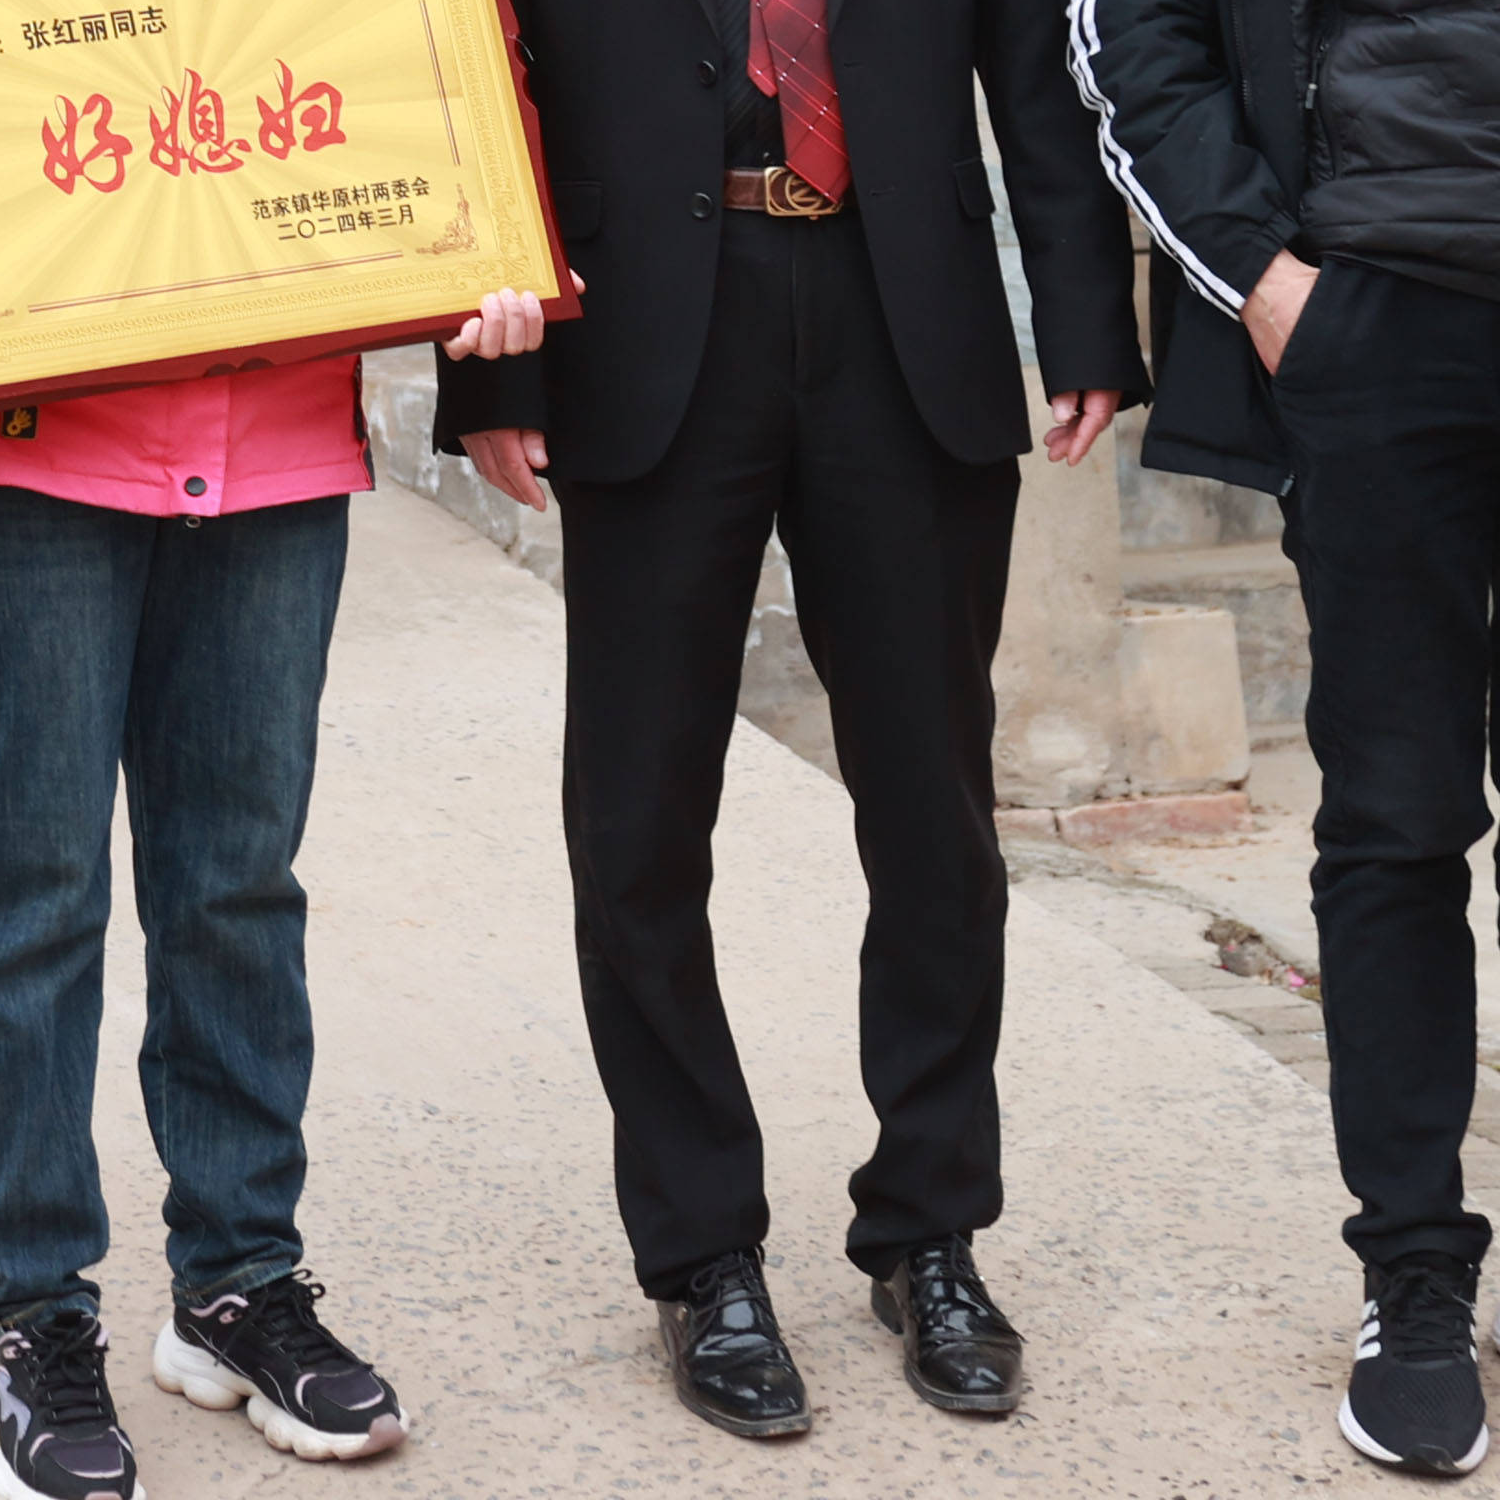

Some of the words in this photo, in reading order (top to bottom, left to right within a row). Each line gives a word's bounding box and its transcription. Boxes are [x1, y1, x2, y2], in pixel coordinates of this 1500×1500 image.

[40, 57, 349, 197] 好媳妇
[250, 176, 432, 221] 范家镇华原村两委会
